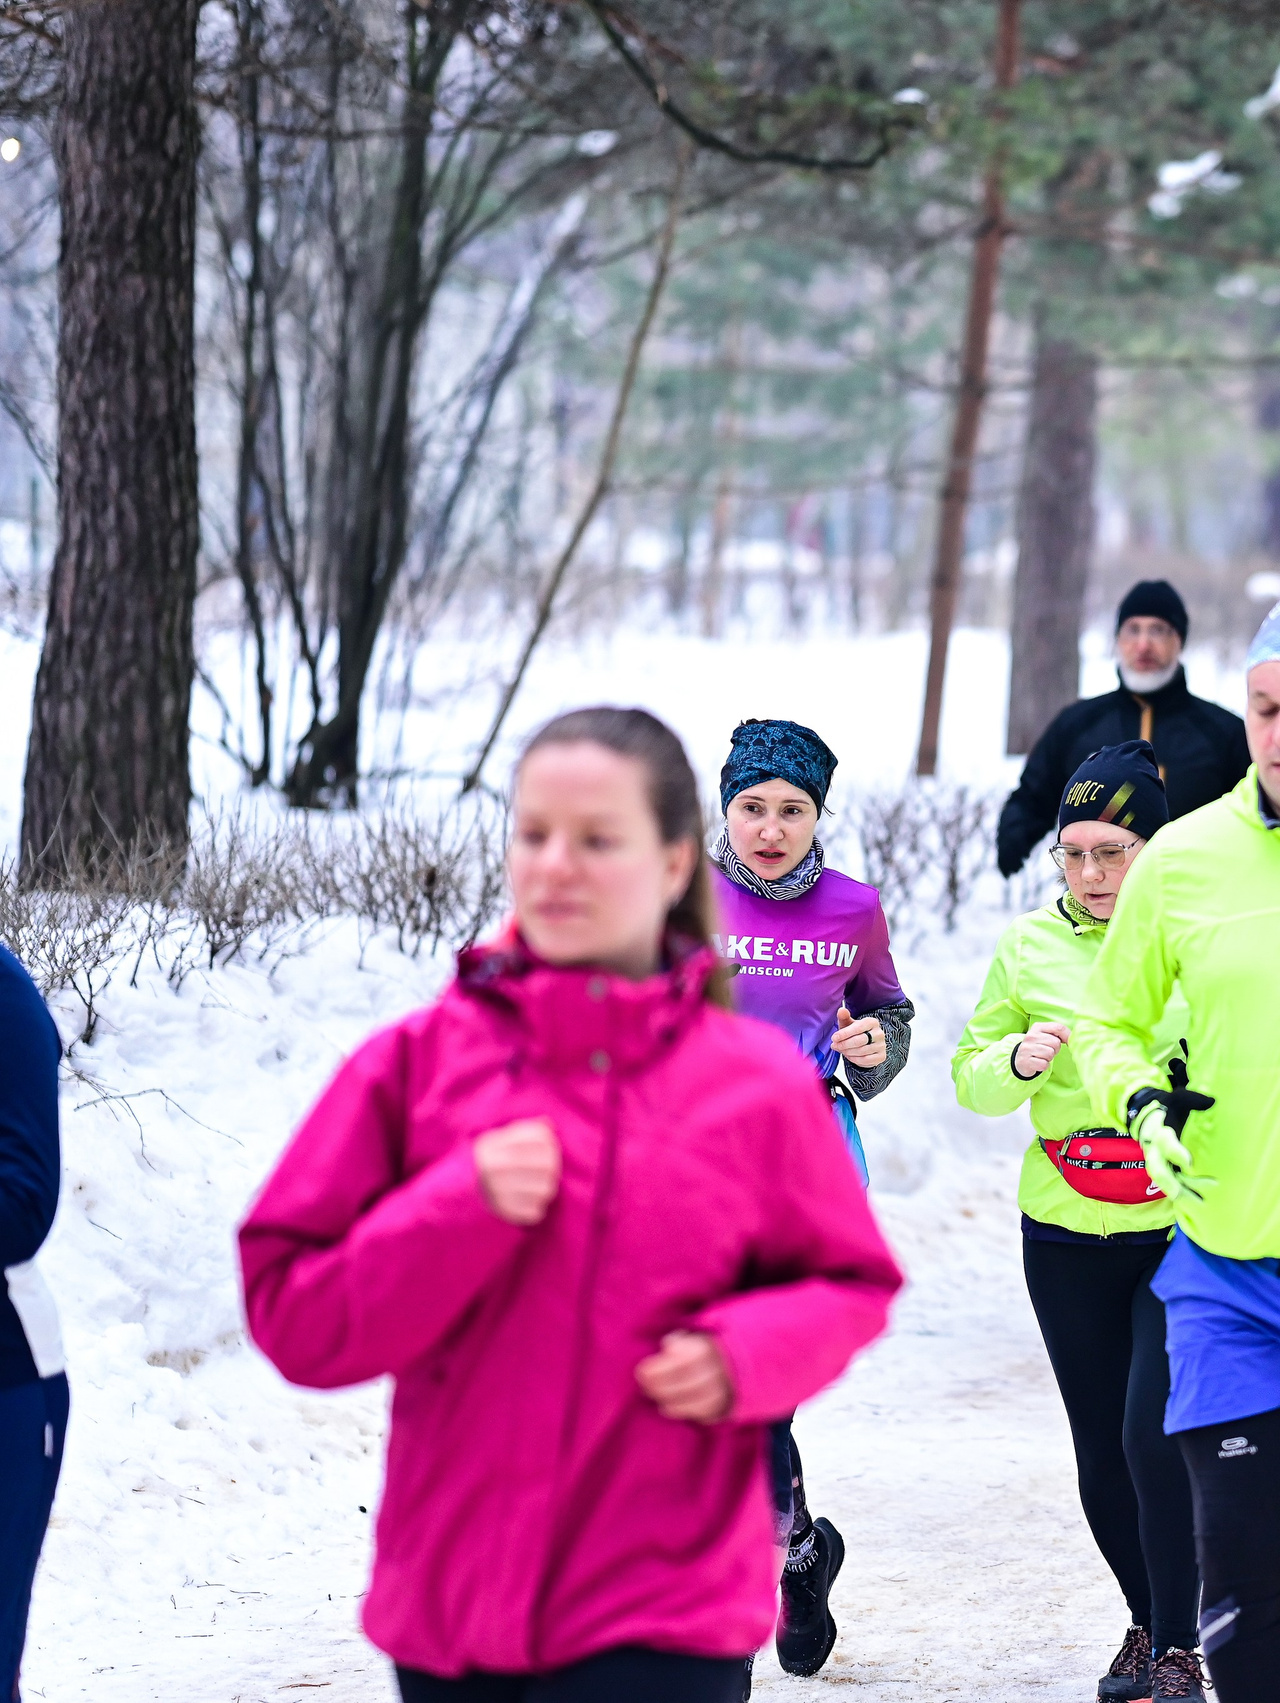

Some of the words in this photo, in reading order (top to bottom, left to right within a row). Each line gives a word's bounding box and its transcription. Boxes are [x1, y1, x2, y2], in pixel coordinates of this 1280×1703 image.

[738, 965, 794, 978] MOSCOW
[1066, 1158, 1088, 1169] NIKE
[1121, 1161, 1145, 1169] NIKE
